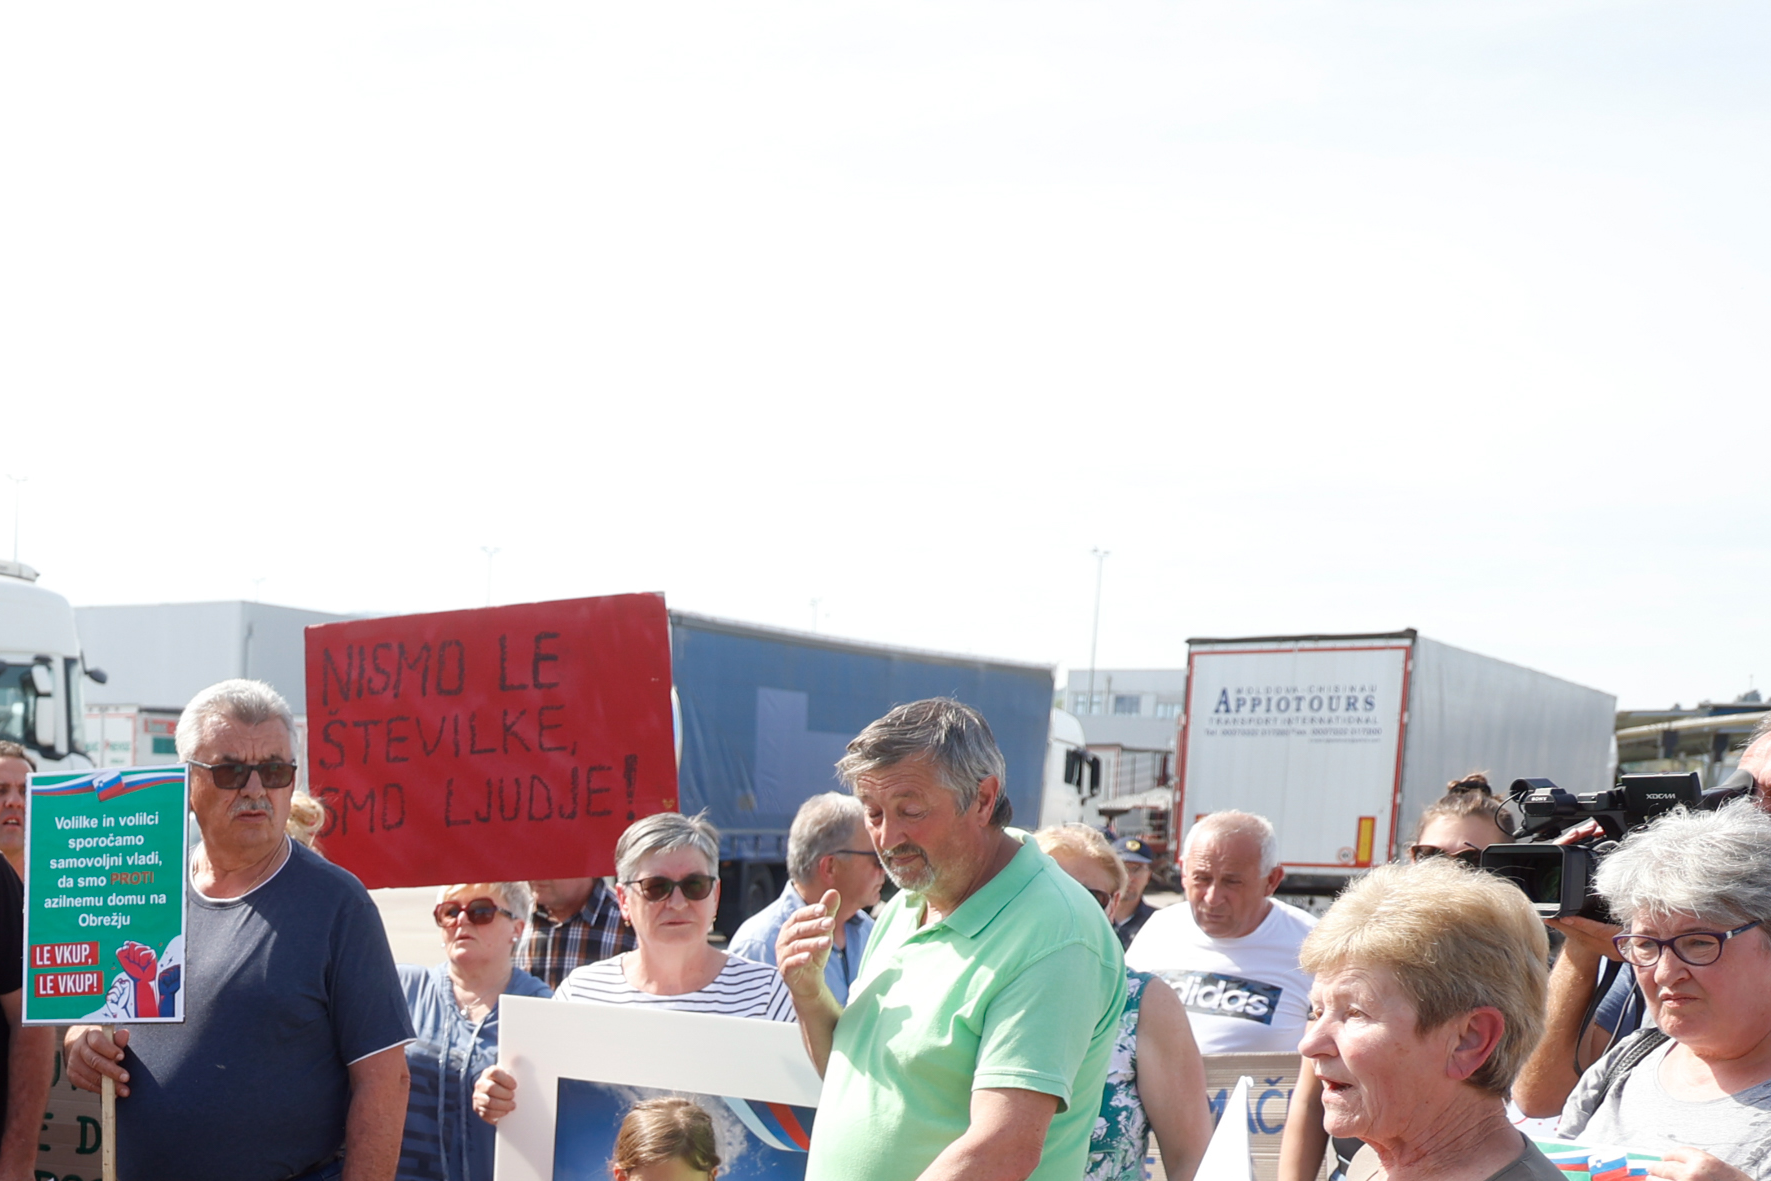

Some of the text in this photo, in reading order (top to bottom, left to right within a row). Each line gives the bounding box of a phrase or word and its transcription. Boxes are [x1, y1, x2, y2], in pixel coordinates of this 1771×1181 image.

[322, 631, 562, 707] NISMO LE
[319, 704, 577, 771] ŠTEVILKE,
[316, 754, 638, 839] SMO LJUDJE!
[55, 811, 159, 829] Volilke in volilci
[68, 833, 144, 851] sporočamo
[49, 851, 163, 870] samovoljni vladi,
[58, 871, 154, 888] da smo PROTI
[44, 893, 167, 908] azilnemu domu na
[78, 913, 131, 929] Obrežju
[36, 944, 93, 965] LE VKUP,
[39, 973, 98, 994] LE VKUP!
[1166, 975, 1270, 1017] didas
